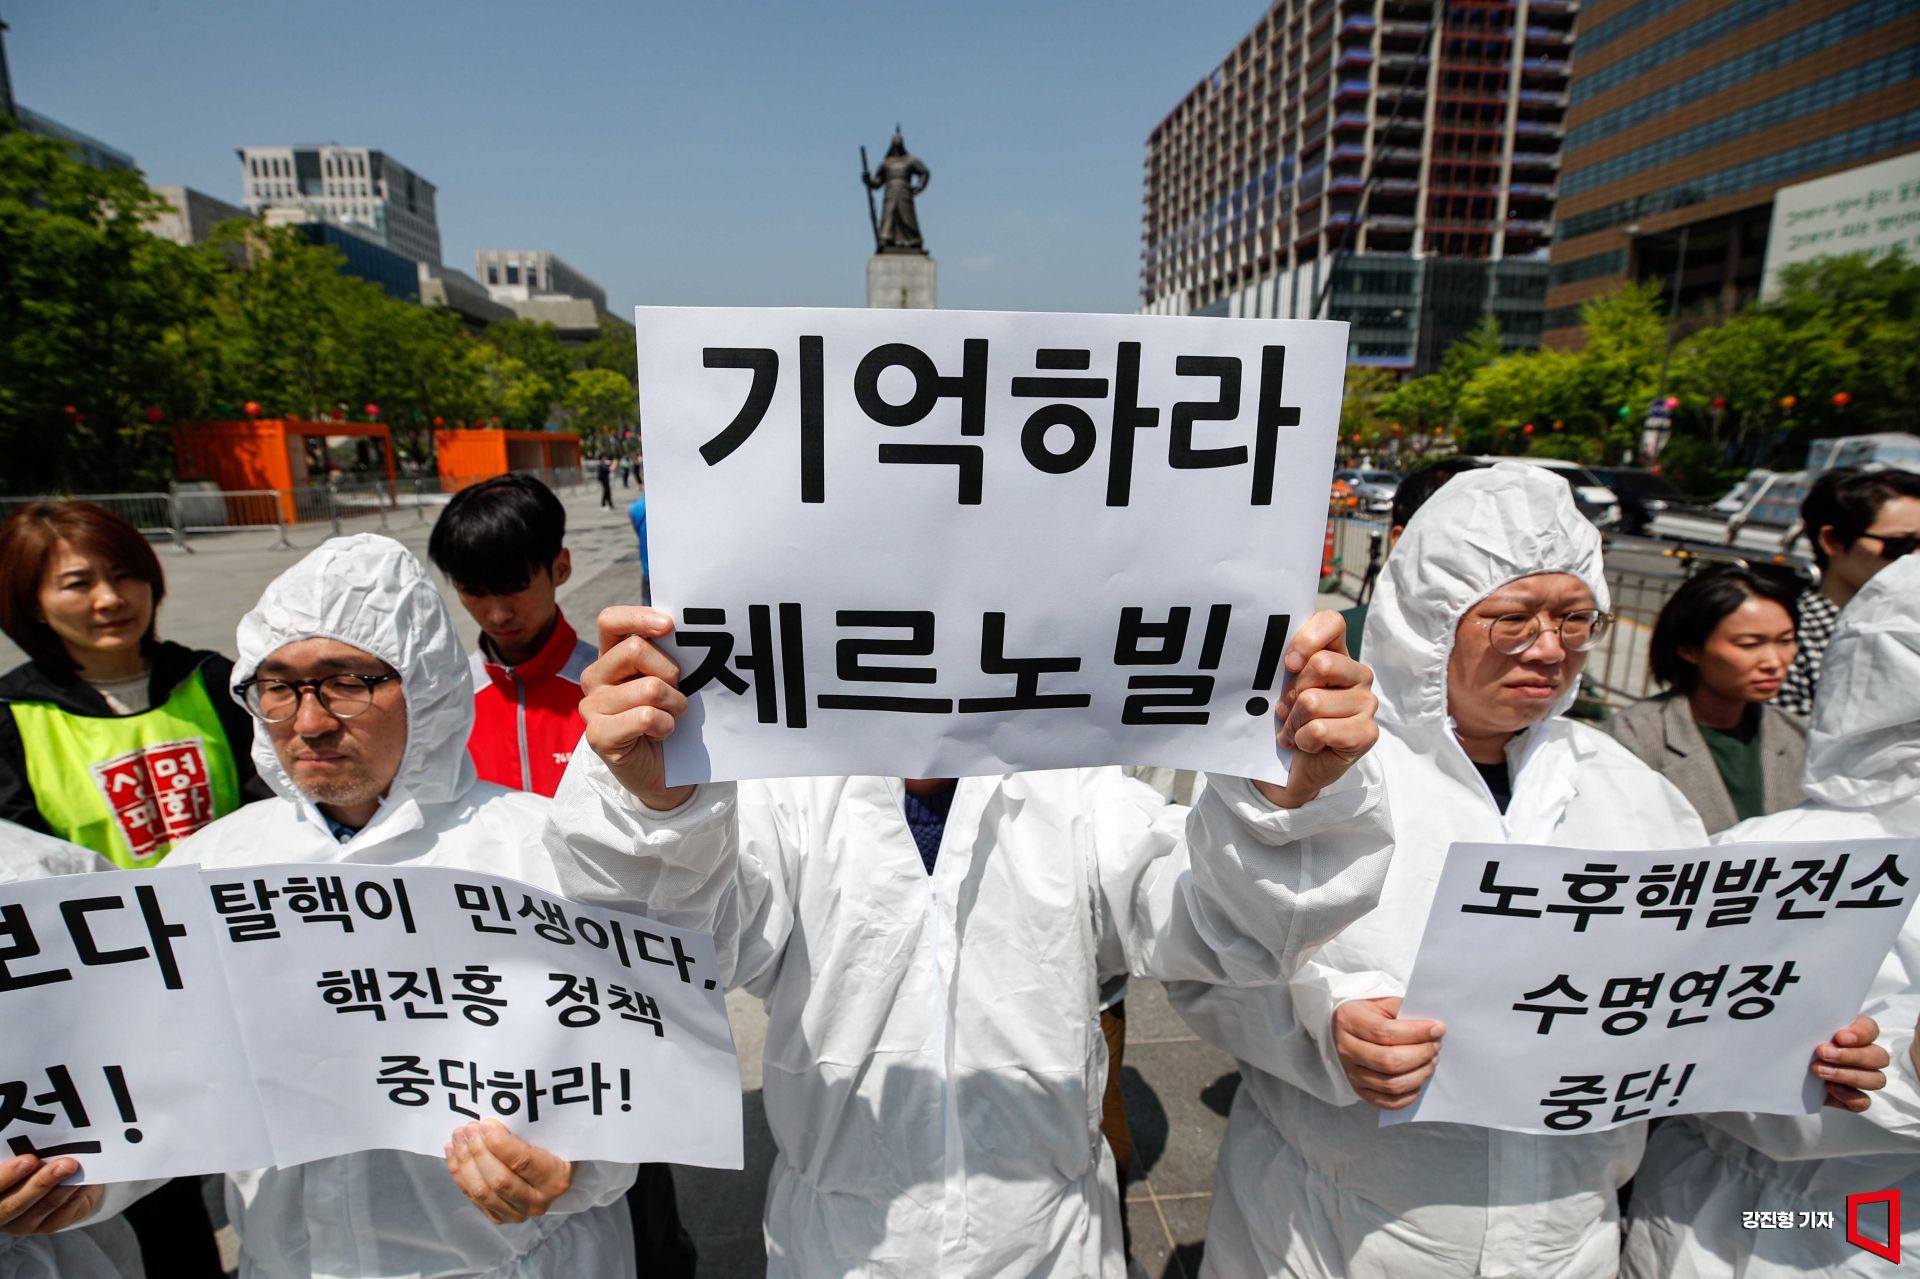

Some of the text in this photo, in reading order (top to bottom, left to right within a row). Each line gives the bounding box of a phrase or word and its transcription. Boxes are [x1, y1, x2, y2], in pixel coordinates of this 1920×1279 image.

[699, 336, 1301, 506] 기억하라
[675, 603, 1291, 729] 체르노빌!
[1461, 853, 1910, 932] 노후핵발전소
[211, 876, 717, 990] 탈핵이 민생이다,
[316, 965, 664, 1037] 핵진흥 정책
[1512, 960, 1801, 1036] 수명연장
[376, 1056, 632, 1122] 중단하라!
[1540, 1063, 1697, 1132] 중단!
